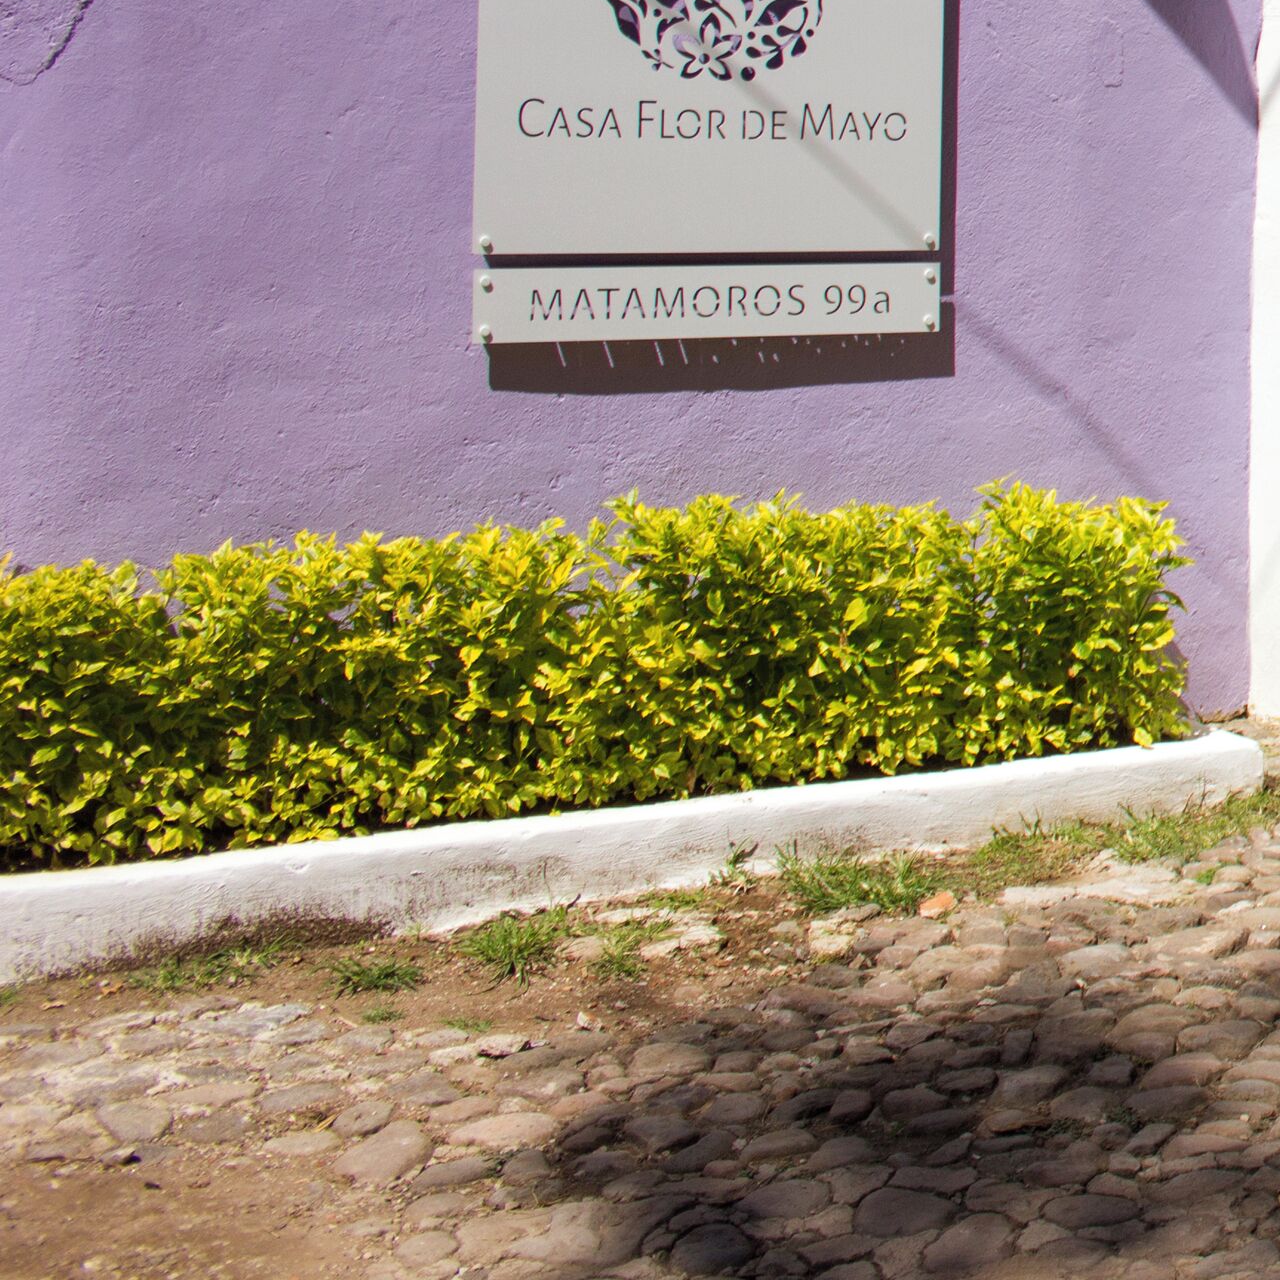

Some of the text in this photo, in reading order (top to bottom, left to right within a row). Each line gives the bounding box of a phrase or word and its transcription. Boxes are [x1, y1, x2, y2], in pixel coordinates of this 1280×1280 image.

[742, 110, 788, 140] DE
[529, 284, 891, 321] MATAMOROS 99a
